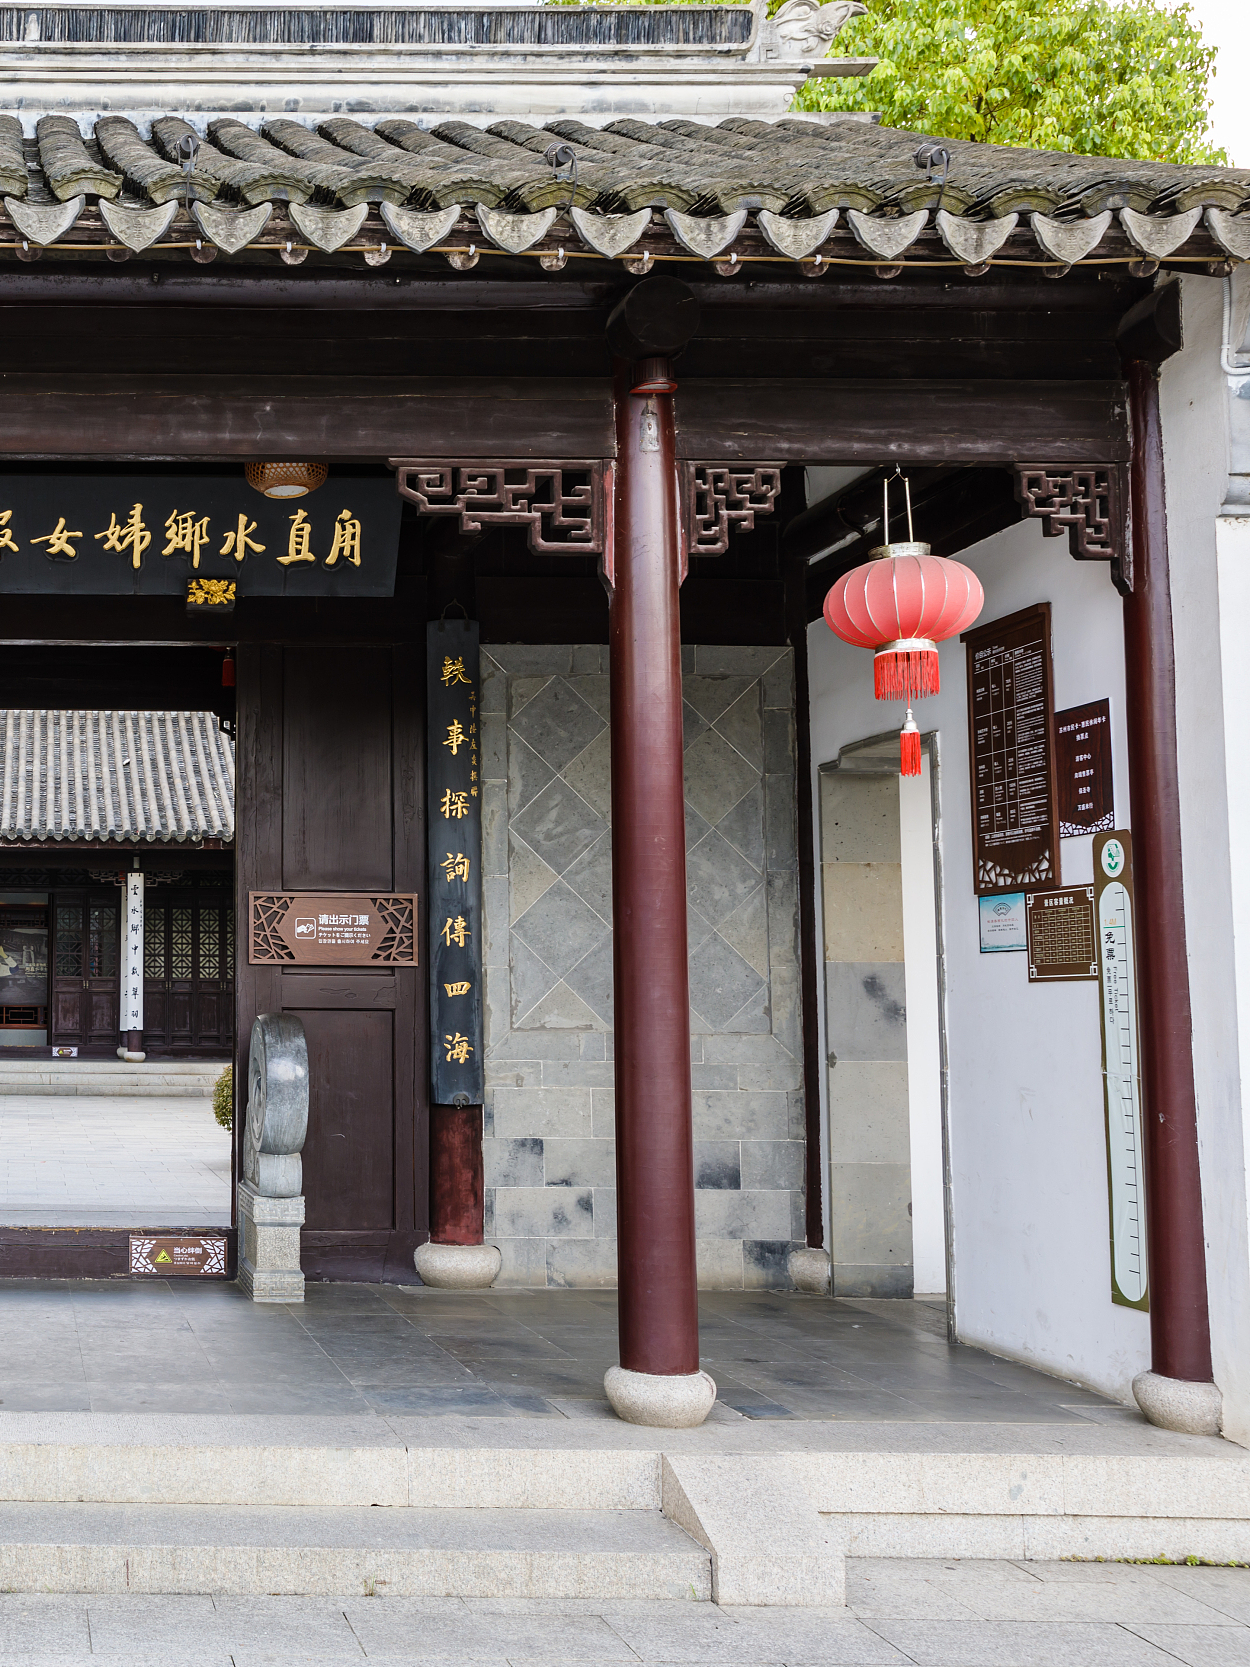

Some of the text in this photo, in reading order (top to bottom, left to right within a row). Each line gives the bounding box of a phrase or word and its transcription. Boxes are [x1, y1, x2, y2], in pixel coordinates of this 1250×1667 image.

[318, 914, 369, 925] 请出示门票
[1105, 932, 1116, 960] 免票
